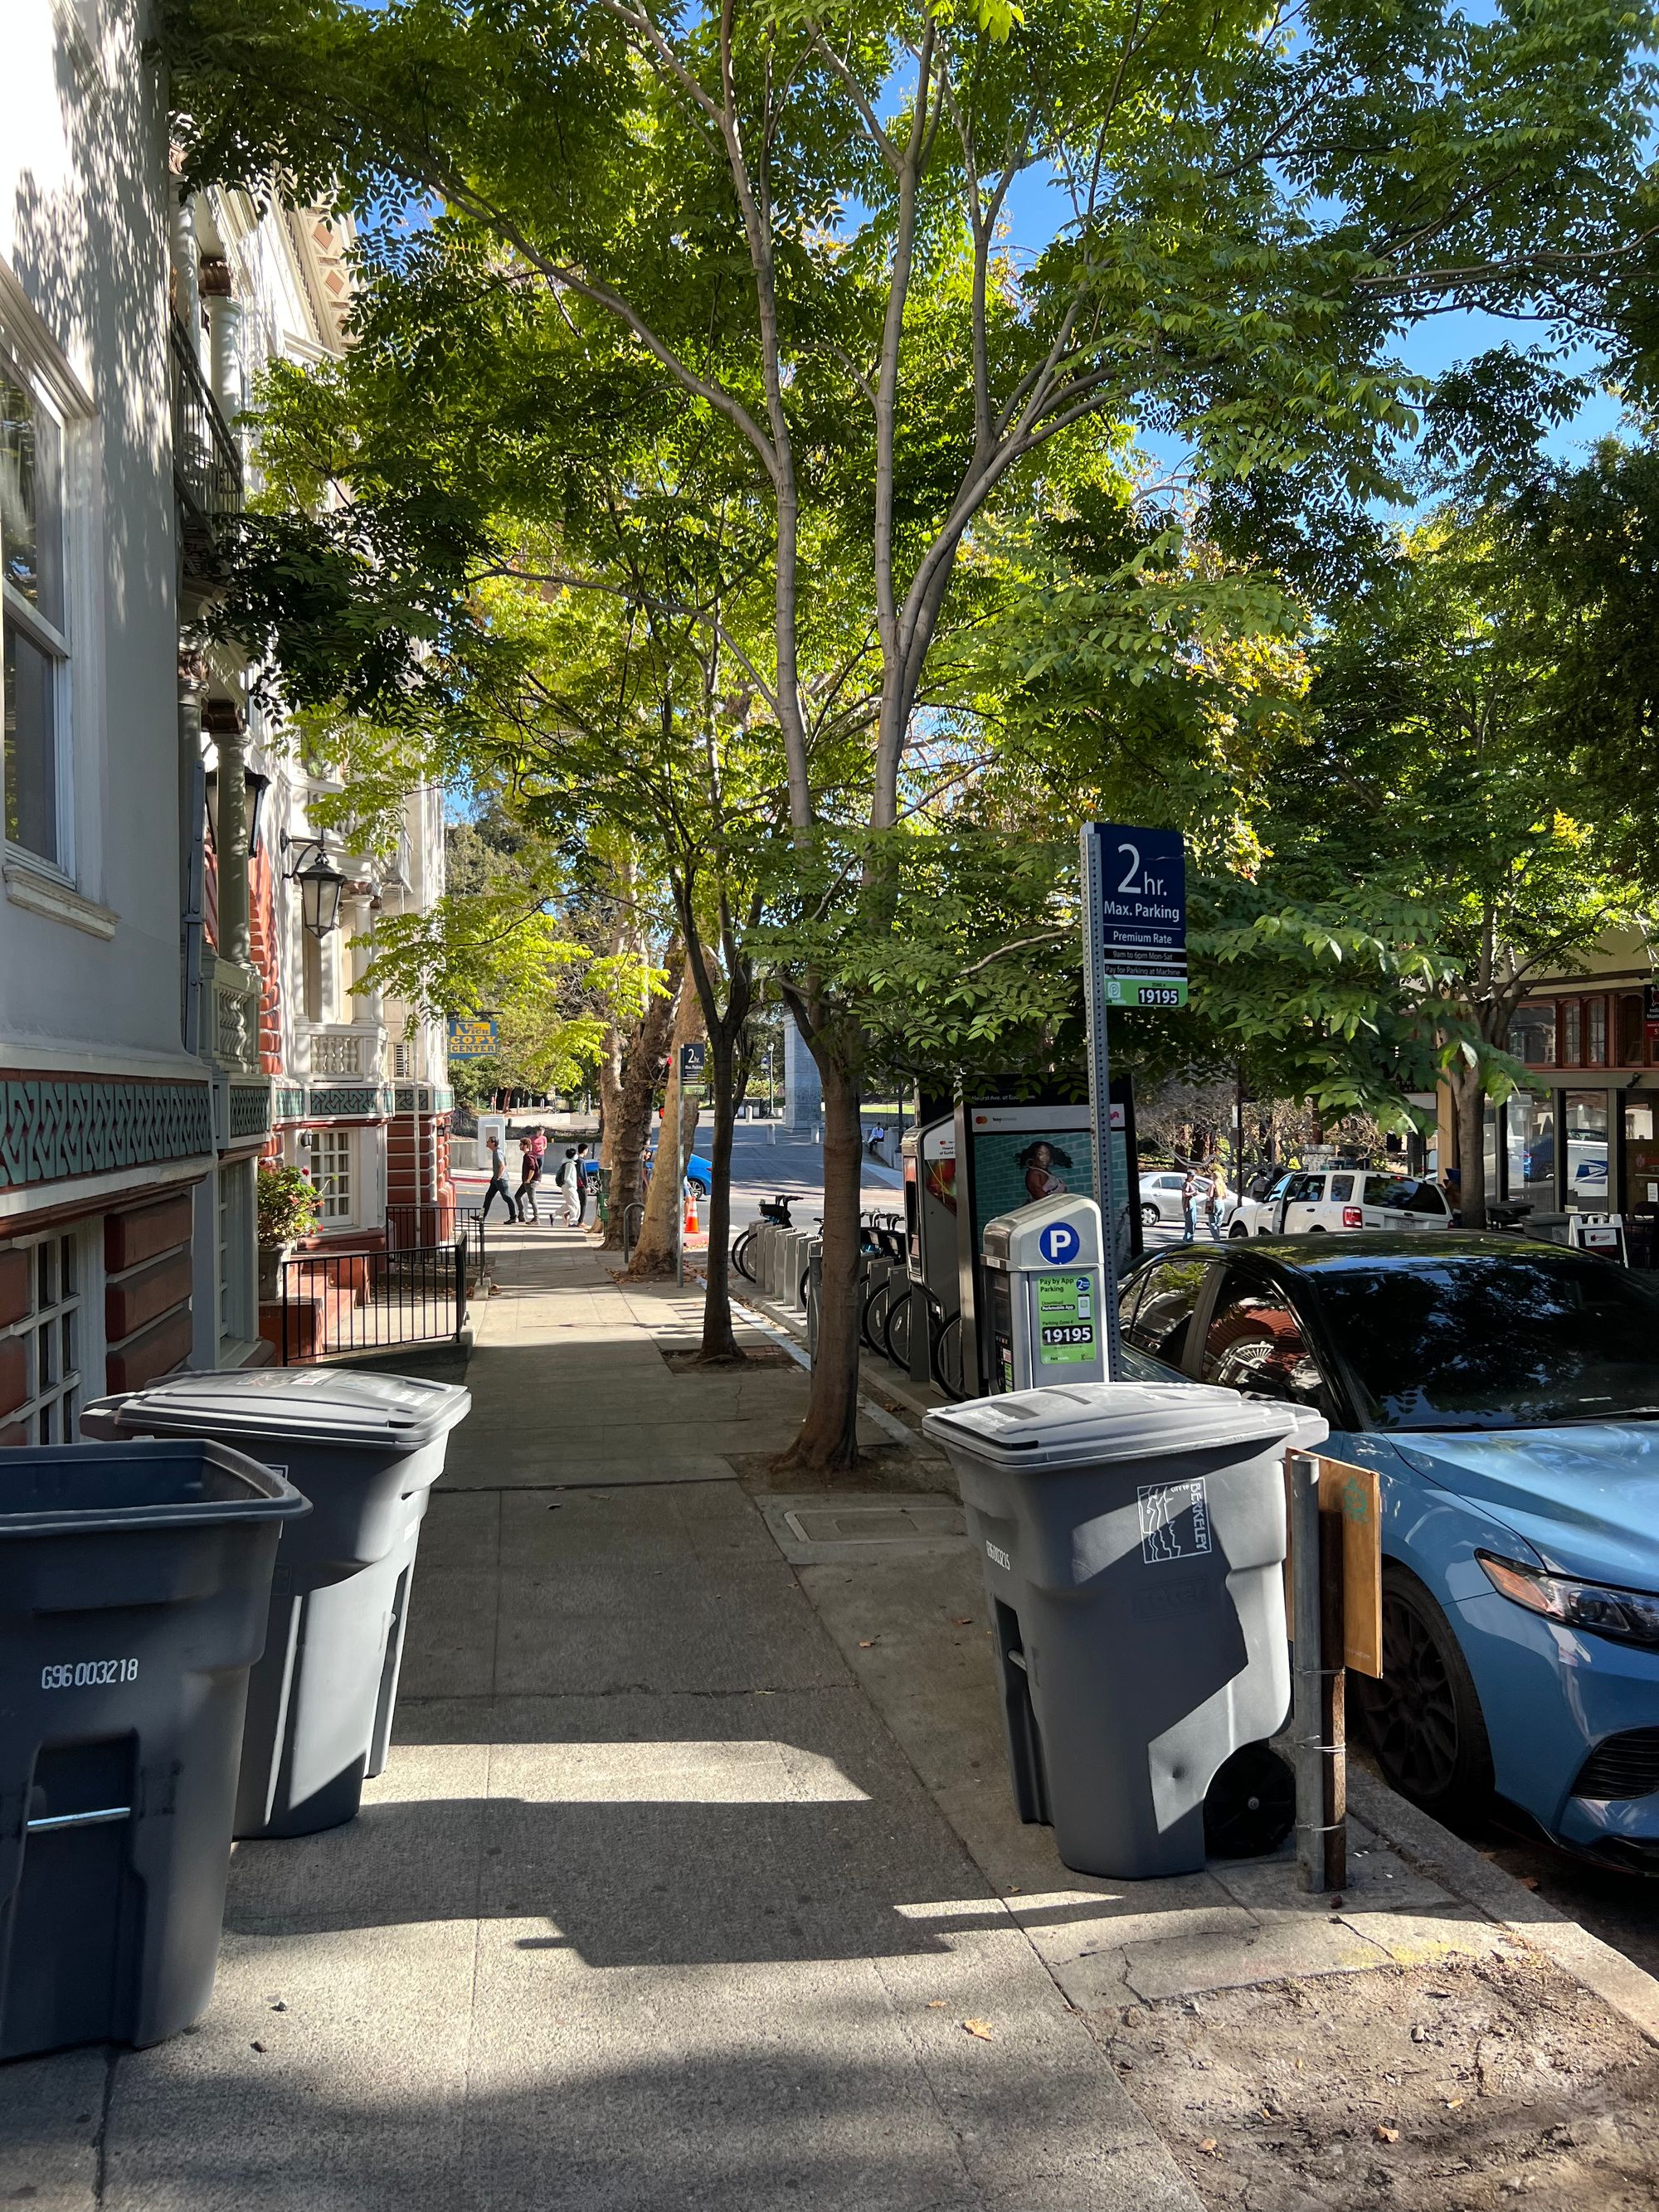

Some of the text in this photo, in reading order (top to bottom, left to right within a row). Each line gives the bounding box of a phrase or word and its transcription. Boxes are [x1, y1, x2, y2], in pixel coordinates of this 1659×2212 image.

[1117, 843, 1167, 897] 2 hr.
[1104, 900, 1180, 923] Max. Parking
[1113, 930, 1173, 944] Premium Rate
[1112, 950, 1126, 959] 9am
[1134, 951, 1148, 960] 6pm
[1149, 952, 1173, 961] Mon-Sat
[1105, 965, 1117, 974] Pay
[1126, 966, 1148, 975] Parking
[1139, 989, 1178, 1004] 19195
[450, 1036, 496, 1044] COPY
[688, 1048, 694, 1062] 2
[1050, 1230, 1072, 1258] P
[1052, 1277, 1060, 1286] by
[1044, 1326, 1092, 1343] 19195
[1190, 1482, 1208, 1550] BERKELEY
